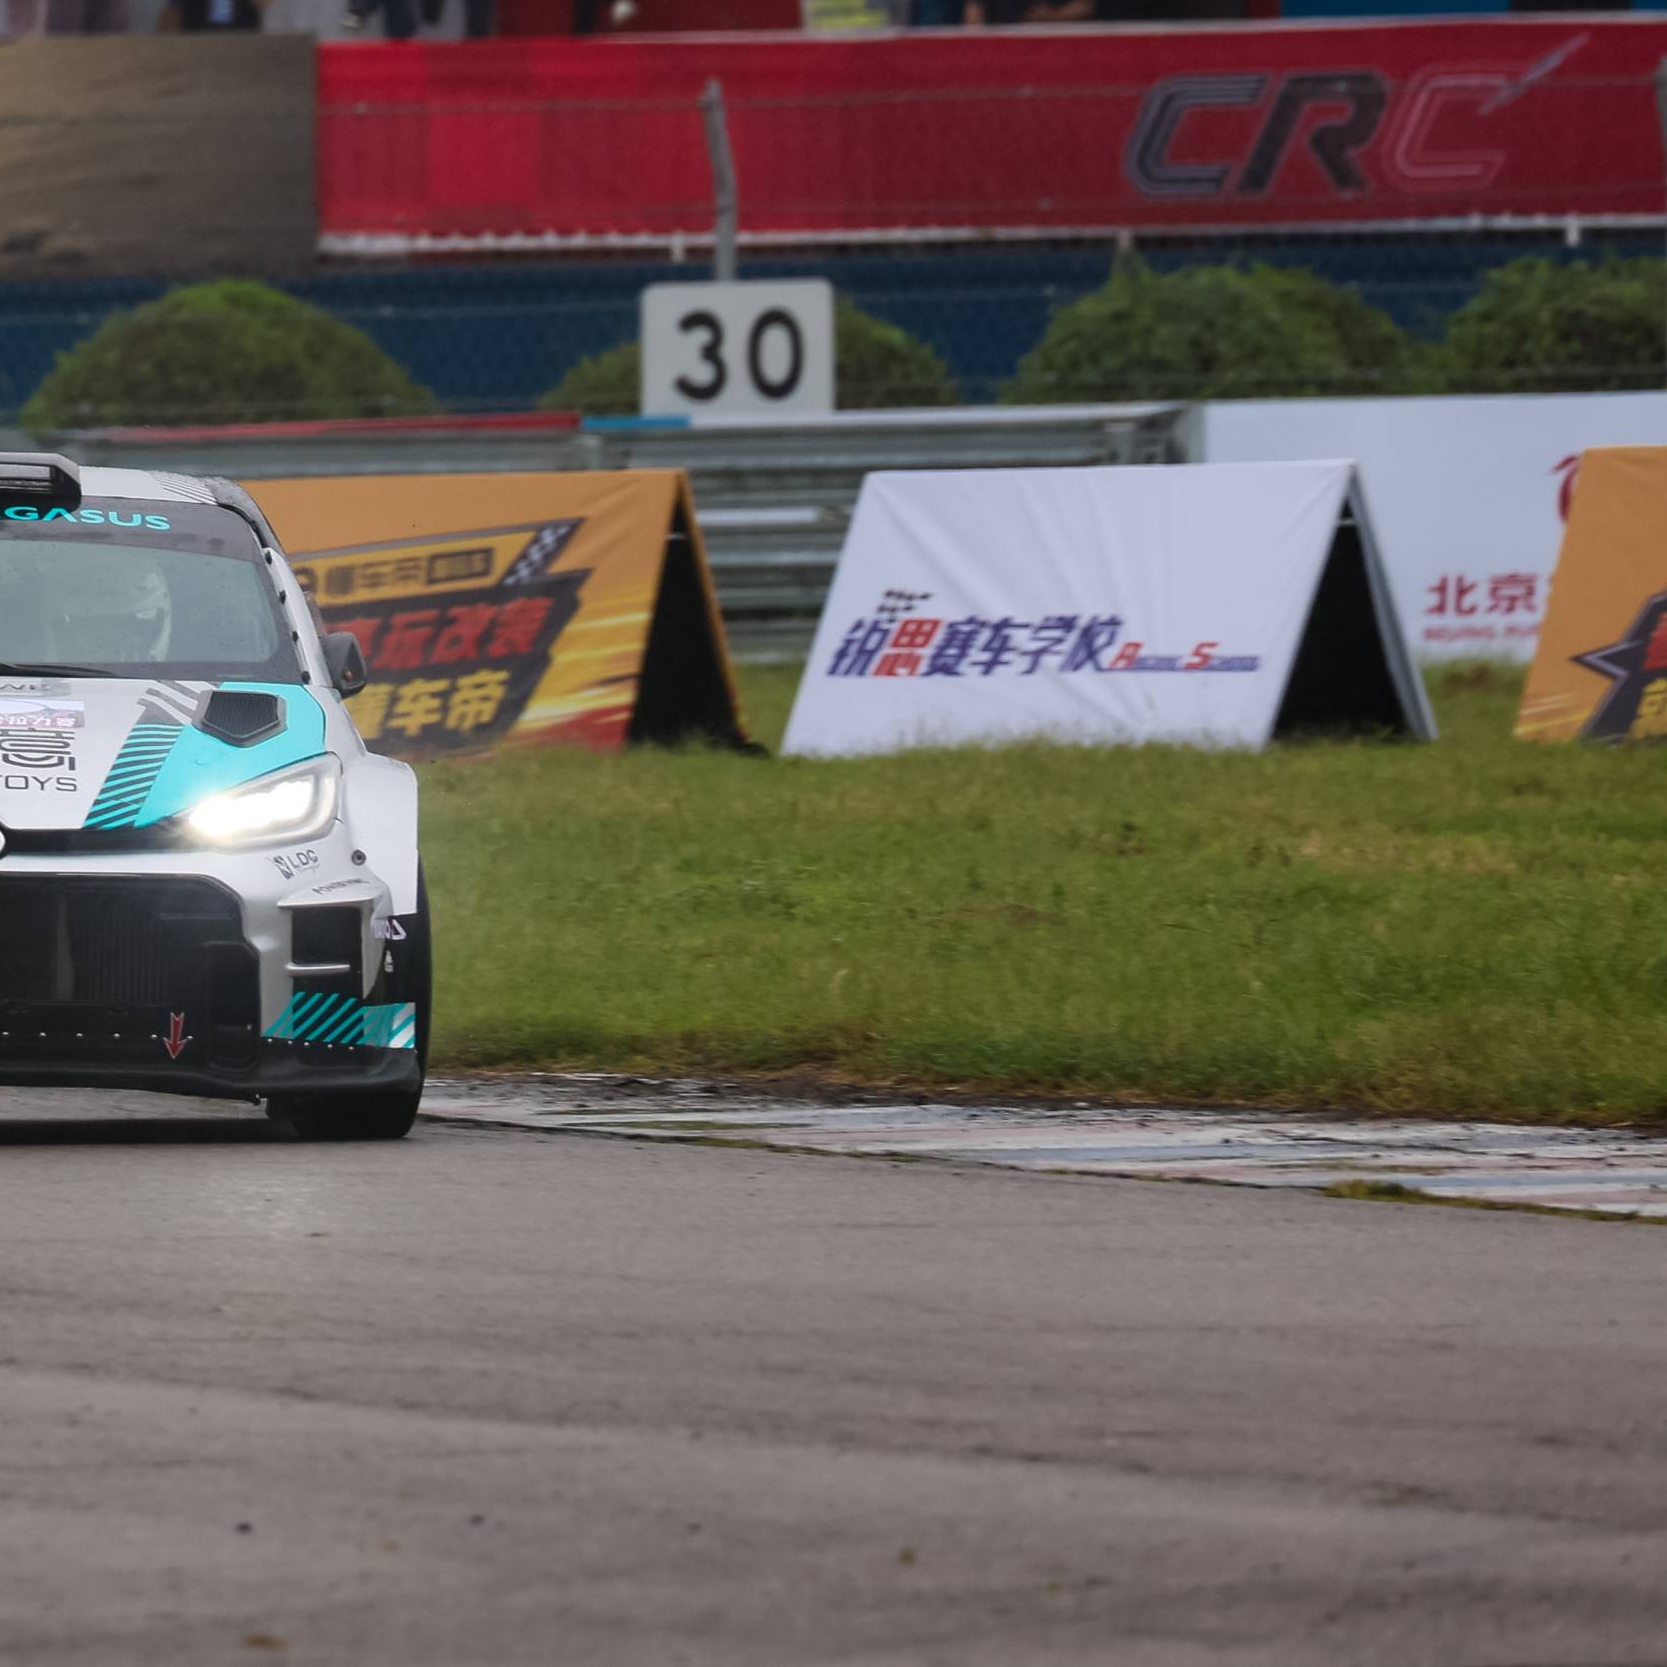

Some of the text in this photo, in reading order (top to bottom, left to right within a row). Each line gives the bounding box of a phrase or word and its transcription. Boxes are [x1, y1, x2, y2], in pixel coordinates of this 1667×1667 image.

[1123, 65, 1527, 203] CRC
[673, 306, 805, 402] 30
[1424, 573, 1539, 617] 北京
[825, 615, 1124, 677] 锐思赛车学校
[286, 848, 320, 870] LDC
